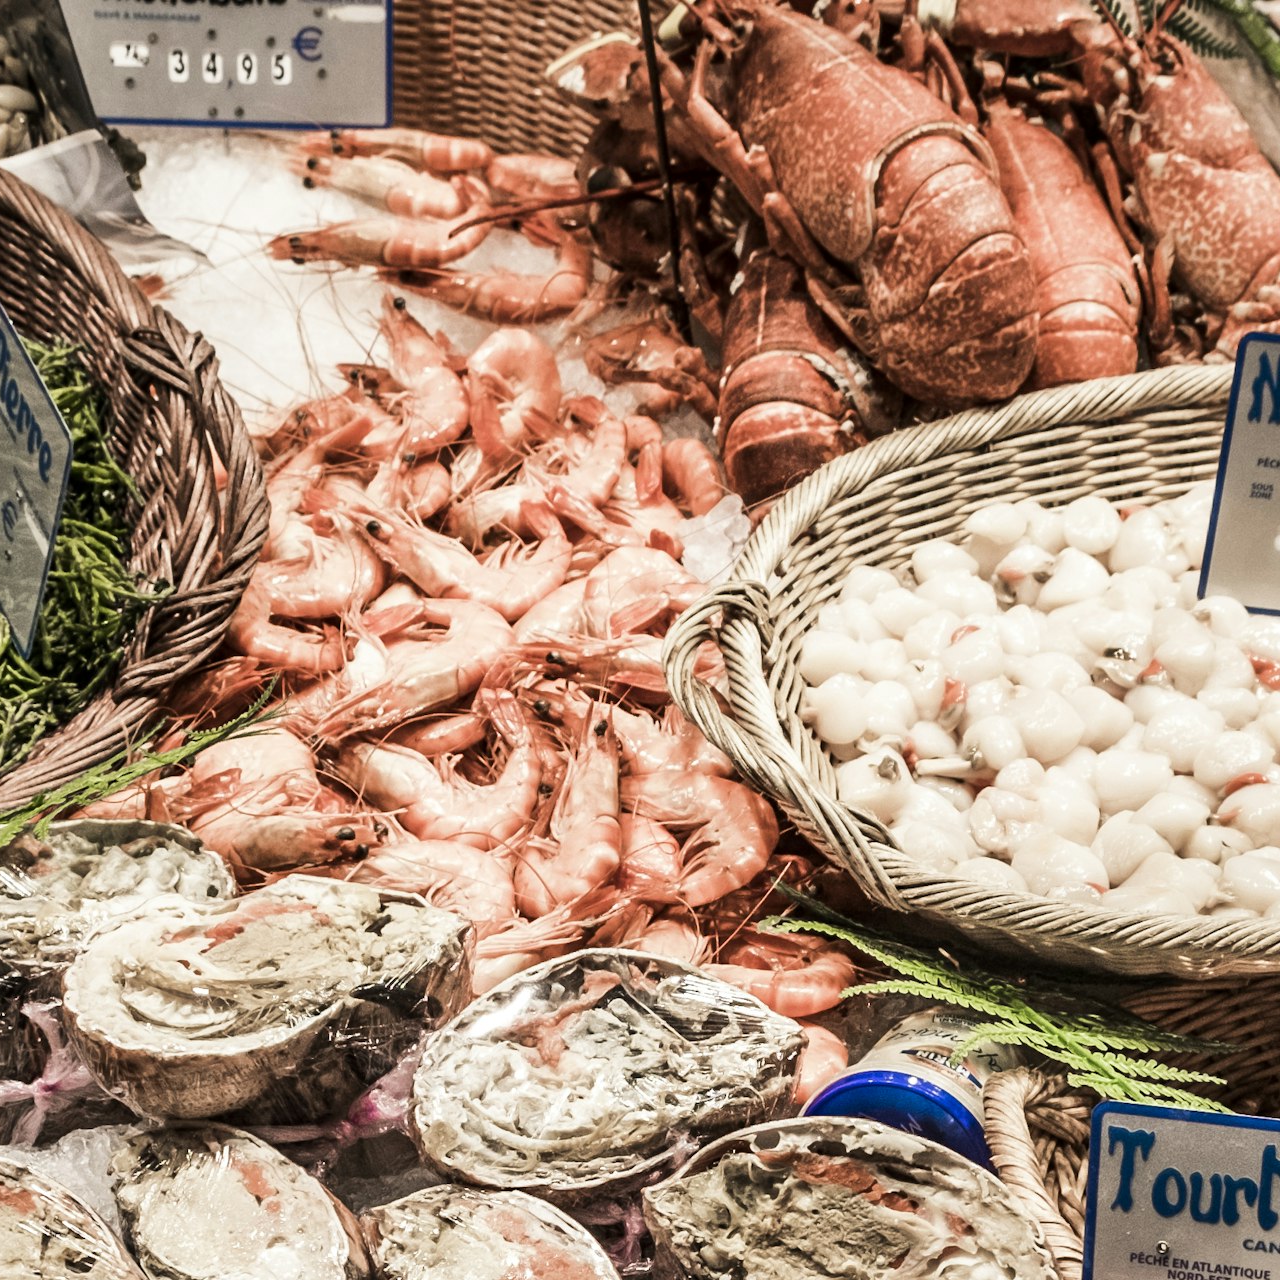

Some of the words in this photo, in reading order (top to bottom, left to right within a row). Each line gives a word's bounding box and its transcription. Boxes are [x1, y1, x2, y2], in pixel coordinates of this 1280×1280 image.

[1130, 1252, 1170, 1267] PÊCHE
[1172, 1258, 1189, 1270] EN
[1191, 1261, 1271, 1280] ATLANTIQUE
